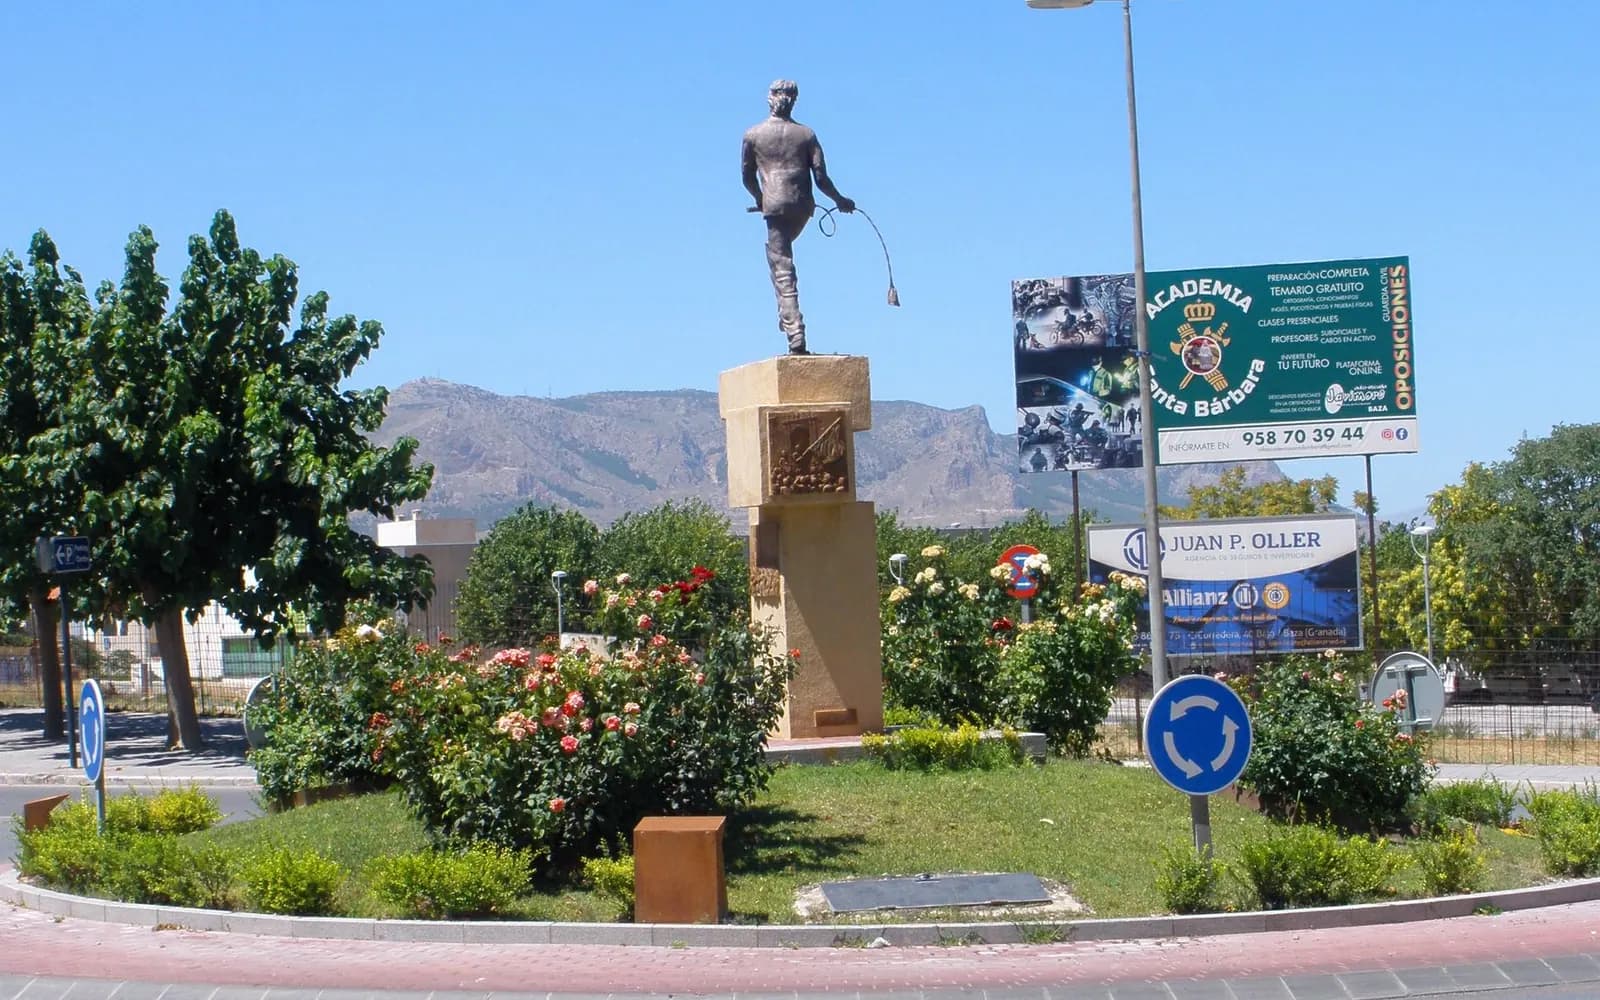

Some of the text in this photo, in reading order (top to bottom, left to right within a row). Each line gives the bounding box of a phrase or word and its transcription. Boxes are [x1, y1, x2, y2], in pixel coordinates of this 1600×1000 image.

[1267, 268, 1370, 282] PREPARACIÓN COMPLETA
[1270, 282, 1364, 296] TEMARIO GRATUITO
[1380, 267, 1390, 322] GUARDIA CIVIL
[1146, 279, 1252, 320] ACADEMIA
[1258, 315, 1339, 327] CLASES PRESENCIALES
[1271, 334, 1318, 343] PROFESORES
[1320, 336, 1342, 344] CABOS
[1353, 335, 1376, 343] ACTIVO
[1389, 264, 1413, 410] OPOSICIONES
[1277, 359, 1380, 370] TU FUTURO PLATAFORMA
[1349, 366, 1382, 375] ONLINE
[1194, 359, 1265, 417] Bárbara
[1168, 441, 1216, 453] INFÓRMATE
[1242, 431, 1277, 446] 958
[1284, 429, 1306, 444] 70
[1312, 428, 1335, 442] 39
[1341, 427, 1364, 441] 44
[1170, 532, 1321, 552] JUAN P. OLLER
[1161, 589, 1228, 607] Allianz
[1283, 628, 1303, 637] Baza
[1305, 627, 1346, 638] (Granada)
